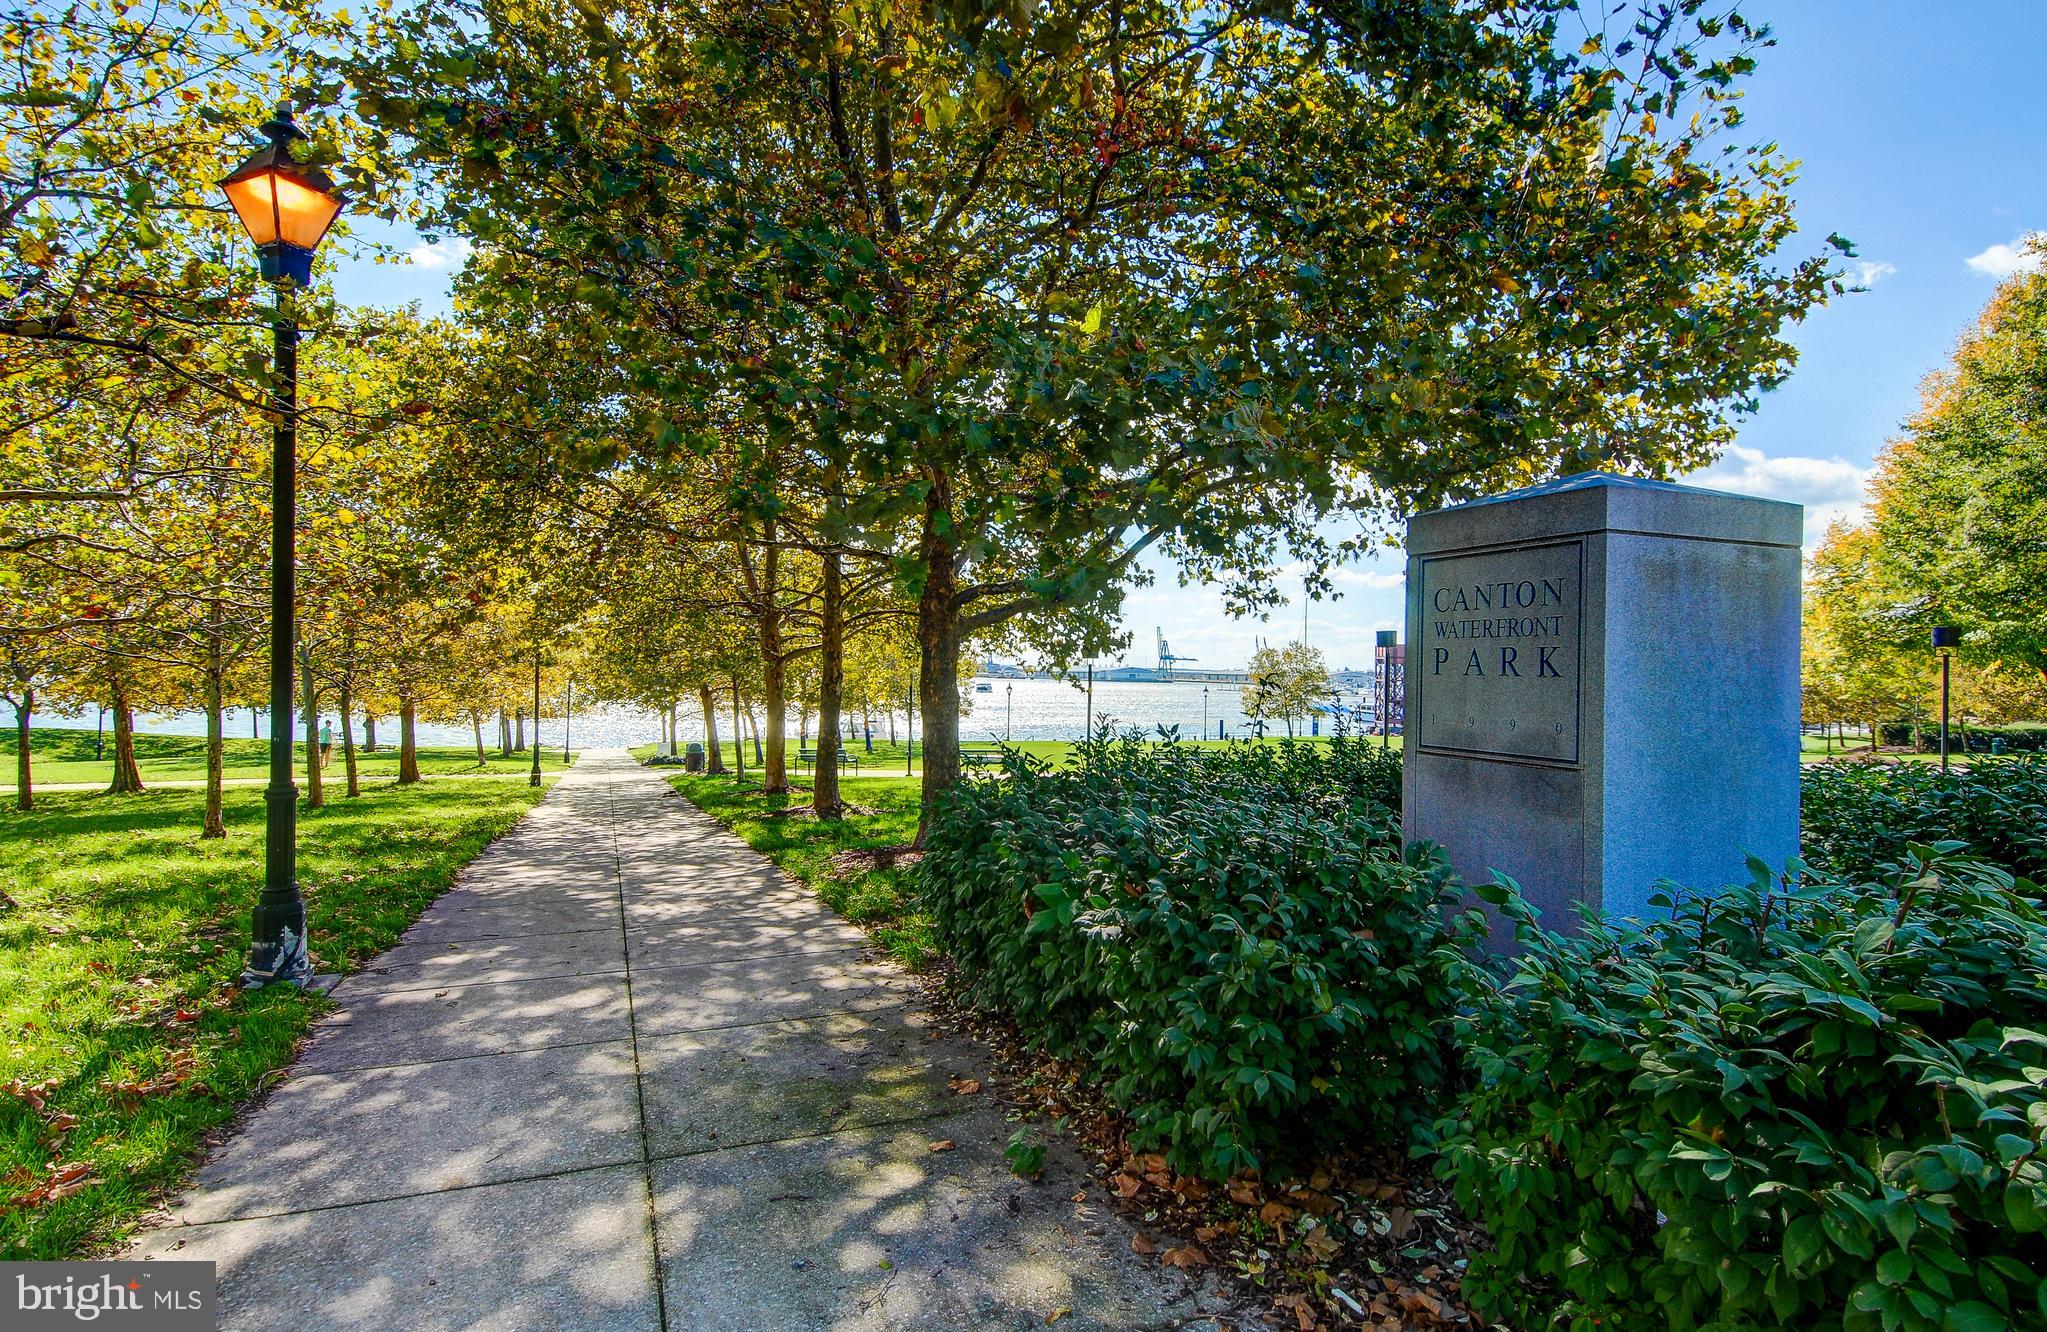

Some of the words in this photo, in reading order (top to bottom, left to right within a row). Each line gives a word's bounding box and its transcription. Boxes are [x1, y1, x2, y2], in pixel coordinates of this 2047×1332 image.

[1434, 577, 1566, 613] CANTON
[1434, 615, 1564, 640] WATERFRONT
[1433, 646, 1563, 678] PARK
[1431, 713, 1563, 735] 1990
